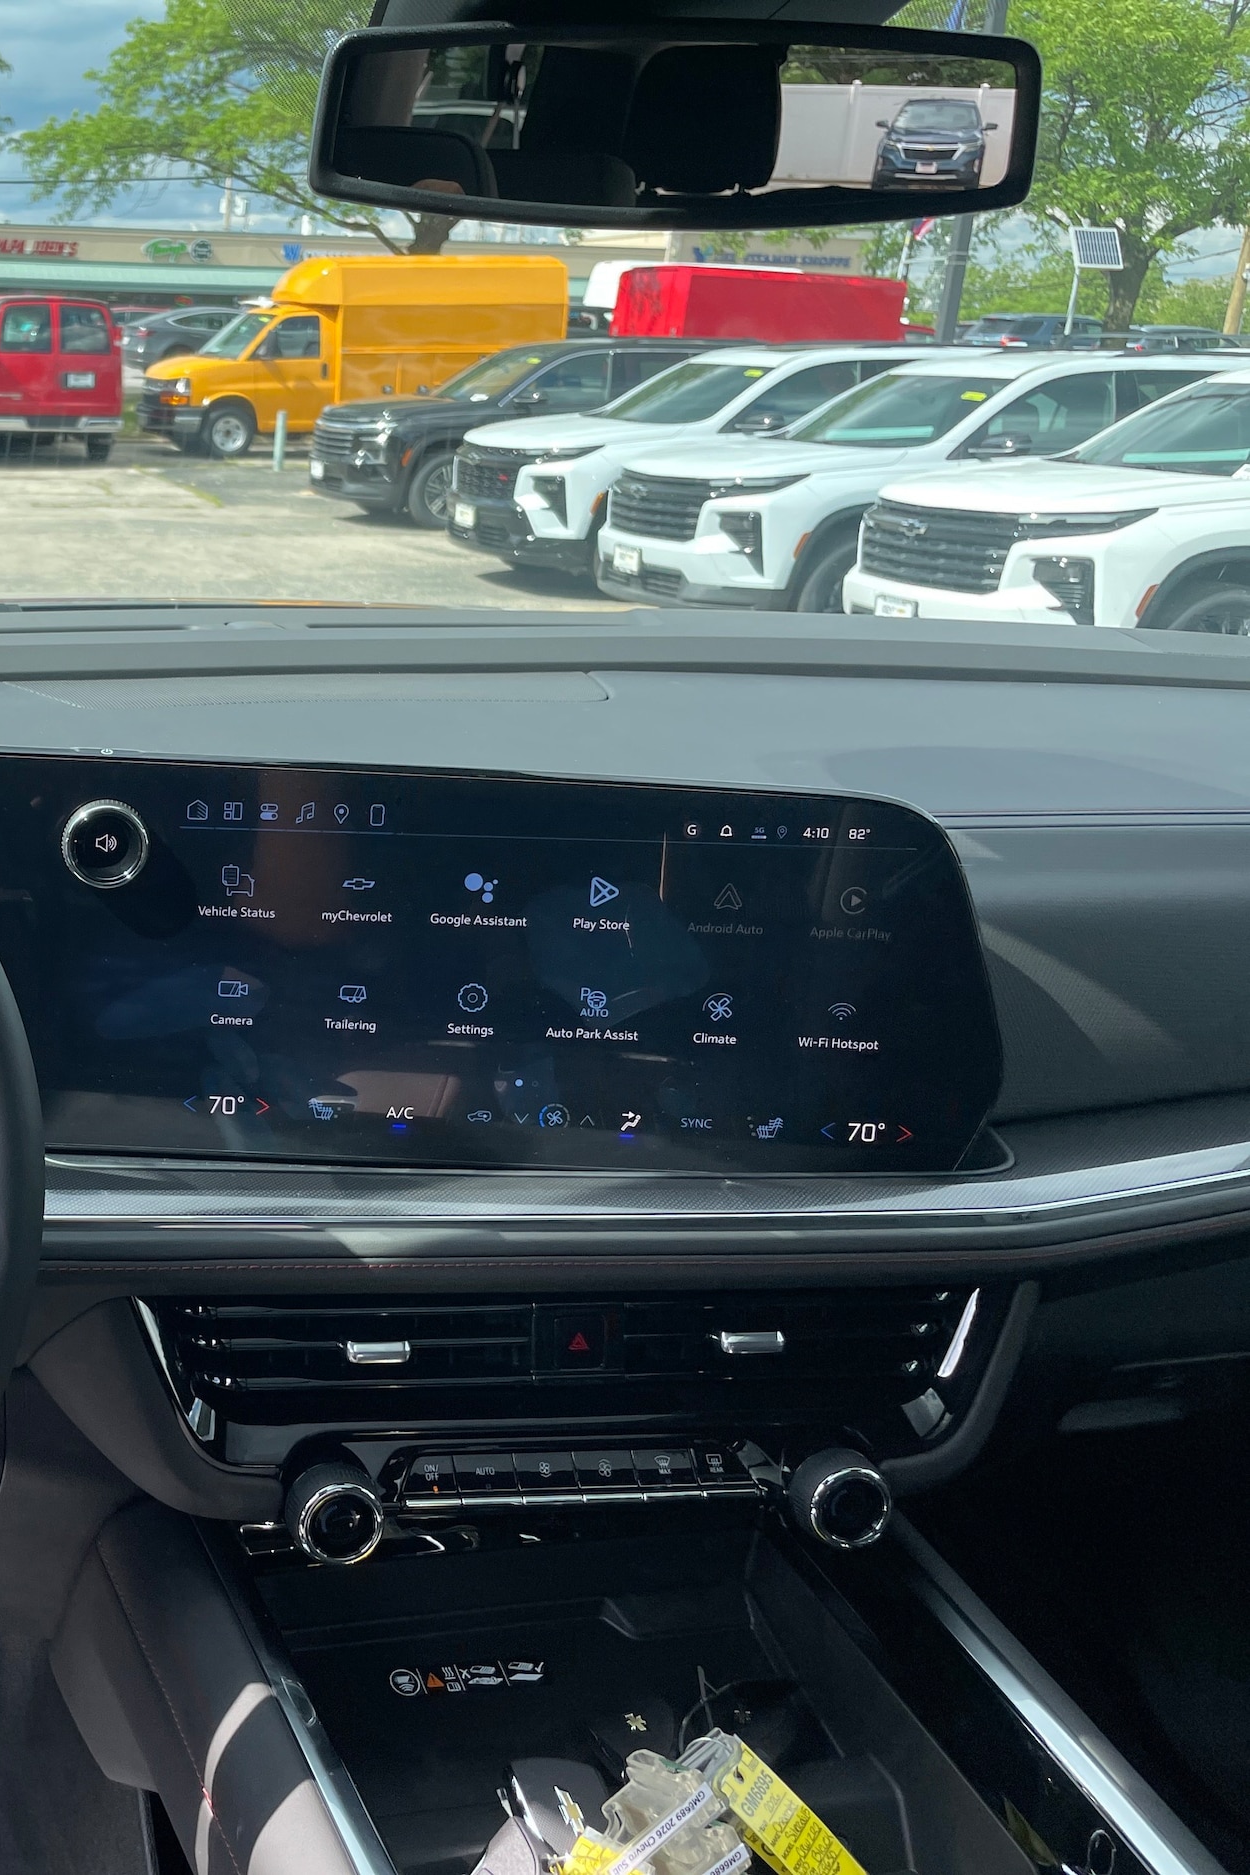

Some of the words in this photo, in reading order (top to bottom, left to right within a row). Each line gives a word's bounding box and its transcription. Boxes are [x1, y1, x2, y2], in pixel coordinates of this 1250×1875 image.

[686, 824, 697, 836] G
[802, 827, 830, 839] 4:10
[848, 828, 871, 840] 82°
[197, 904, 238, 919] Vehicle
[240, 905, 276, 920] Status
[321, 909, 393, 924] myChevrolet
[430, 912, 471, 928] Google
[474, 914, 528, 928] Assistant
[573, 917, 596, 932] Play
[598, 918, 630, 931] Store
[687, 922, 733, 934] Android
[735, 923, 764, 936] Auto
[810, 926, 844, 940] Apple
[846, 927, 892, 943] CarPlay
[210, 1013, 254, 1028] Camera
[579, 1008, 609, 1018] AUTO
[324, 1017, 377, 1033] Trailering
[447, 1022, 494, 1037] Settings
[545, 1027, 573, 1039] Auto
[575, 1028, 601, 1040] Park
[603, 1029, 639, 1042] Assist
[693, 1032, 737, 1046] Climate
[798, 1037, 829, 1049] Wi-Fi
[831, 1038, 879, 1052] Hotspot
[208, 1095, 245, 1115] 70°
[386, 1106, 415, 1121] A/C
[680, 1117, 713, 1130] SYNC
[846, 1122, 886, 1142] 70°
[424, 1463, 439, 1474] ON/
[475, 1466, 495, 1476] AUTO
[658, 1467, 672, 1475] MAX
[709, 1465, 724, 1474] REAR
[425, 1472, 440, 1482] OFF
[740, 1769, 774, 1818] GM6695
[676, 1790, 706, 1822] GM6689
[656, 1820, 676, 1838] 2026
[628, 1836, 656, 1862] Chevro
